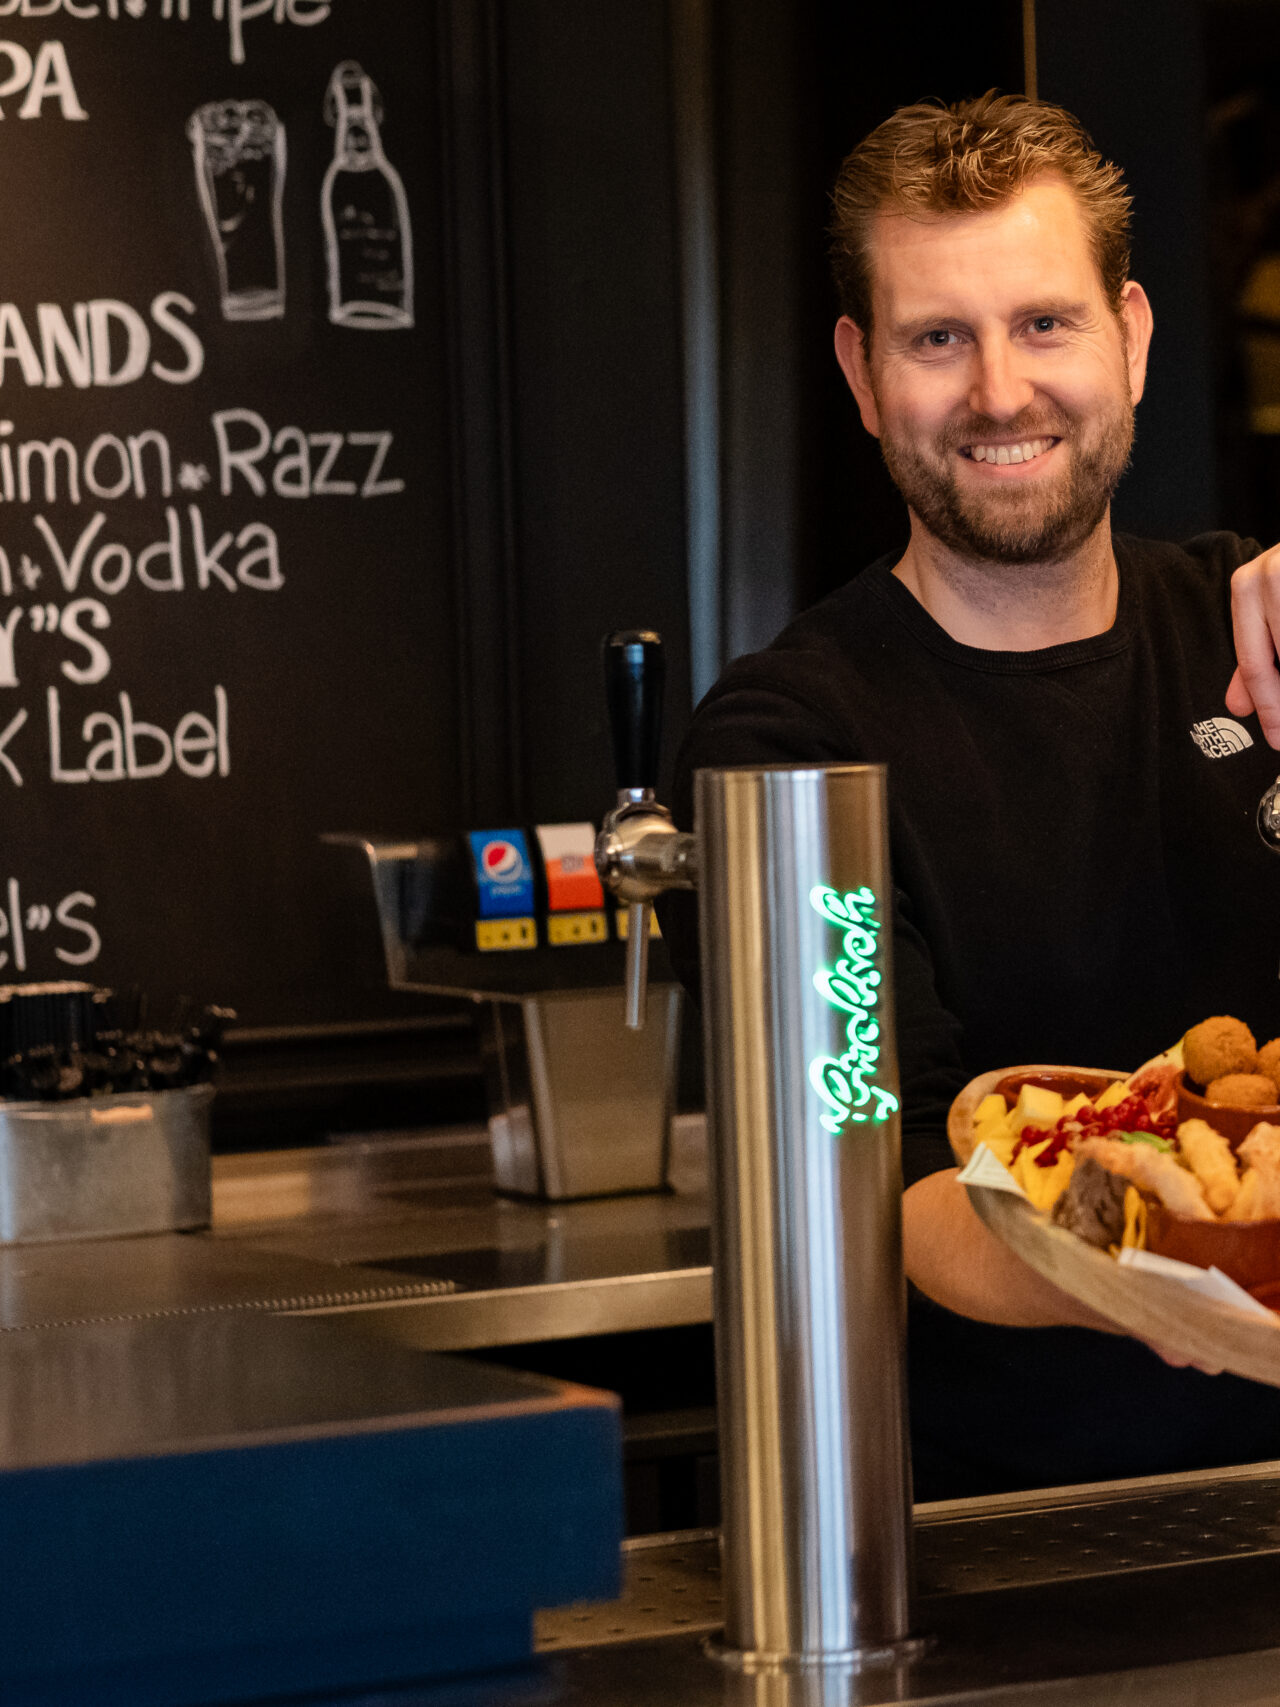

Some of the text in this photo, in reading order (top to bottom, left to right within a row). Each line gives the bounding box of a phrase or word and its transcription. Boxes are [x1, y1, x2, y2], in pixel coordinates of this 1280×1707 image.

[0, 291, 204, 389] ANDS
[0, 407, 405, 503] imon Razz
[33, 504, 285, 594] Vodka
[47, 684, 231, 783] Label
